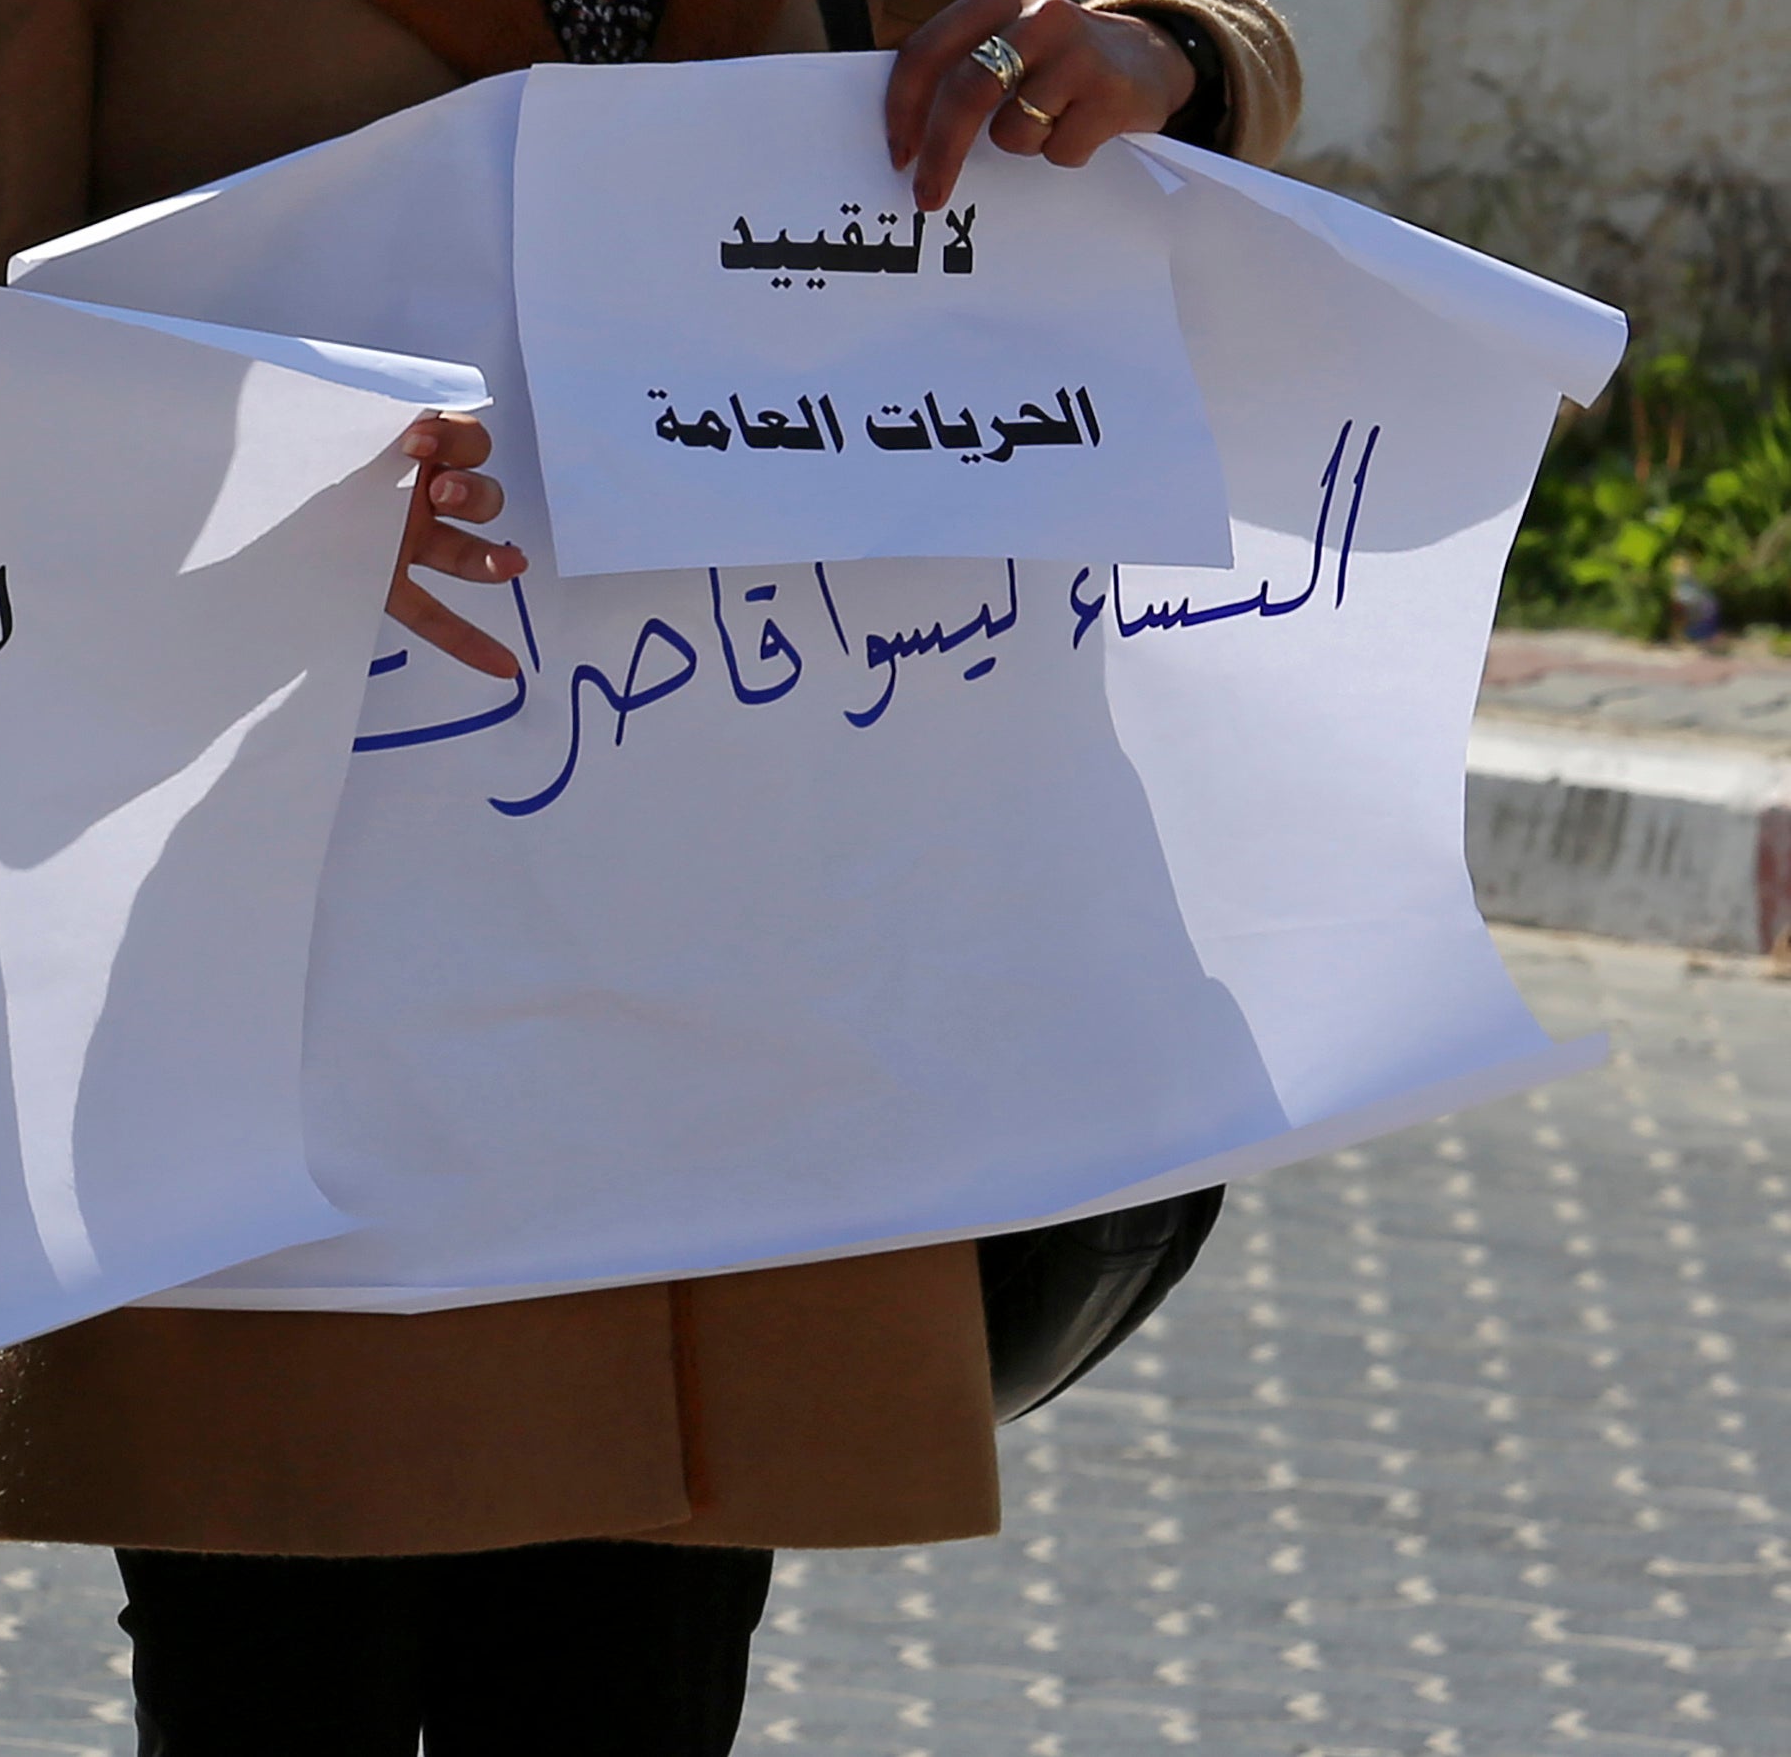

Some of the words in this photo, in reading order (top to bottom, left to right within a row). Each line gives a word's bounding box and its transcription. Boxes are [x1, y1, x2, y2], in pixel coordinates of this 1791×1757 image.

[719, 205, 926, 290] لتقييد
[942, 202, 976, 275] لا
[647, 388, 844, 454] العامة
[866, 385, 1101, 464] الحريات
[352, 541, 803, 816] قاصرات
[815, 558, 1017, 728] ليسوا
